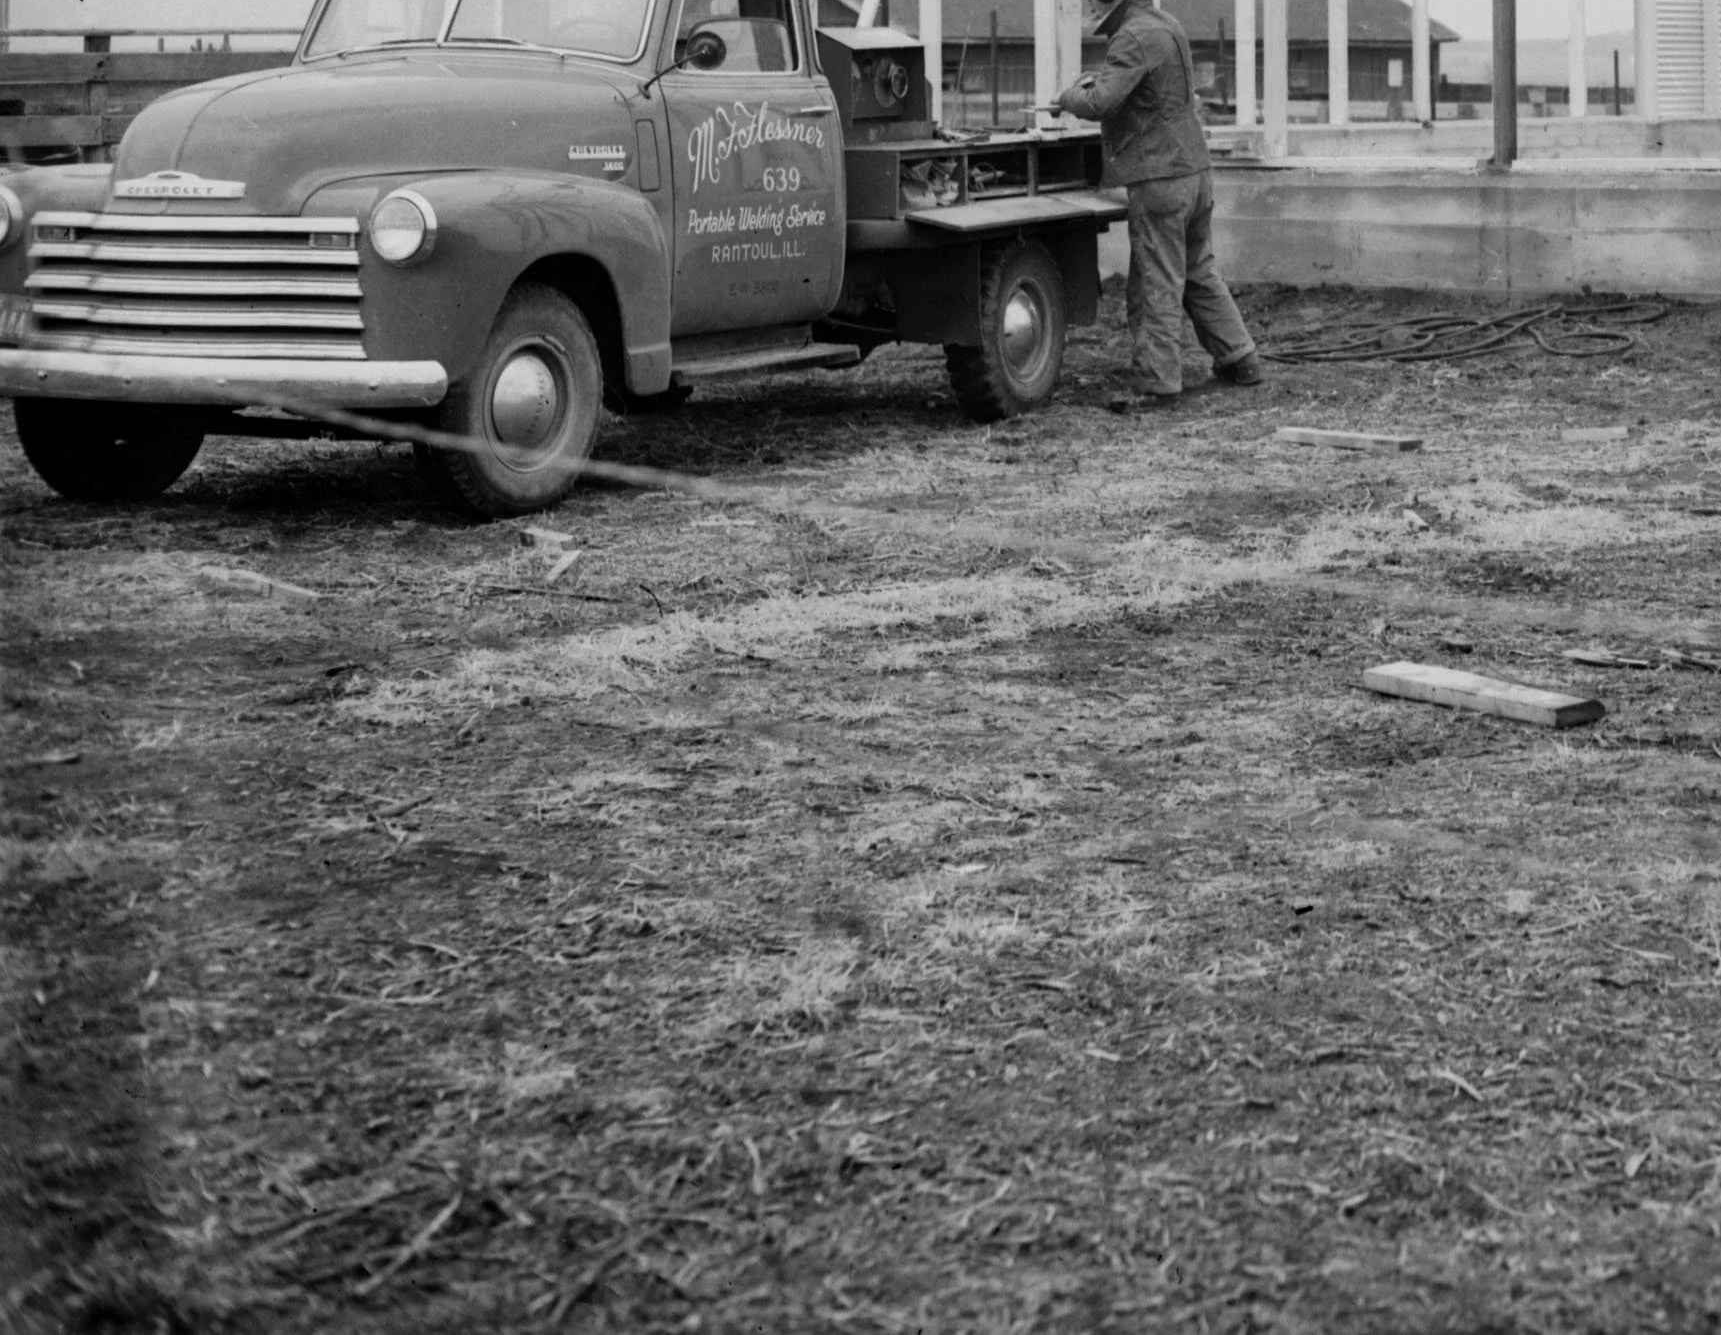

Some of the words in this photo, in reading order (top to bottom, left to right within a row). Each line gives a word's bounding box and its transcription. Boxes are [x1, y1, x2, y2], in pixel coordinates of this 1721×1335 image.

[567, 145, 626, 157] CHEVROLET
[763, 166, 801, 192] 639
[127, 185, 214, 195] CHEVROLET
[688, 207, 736, 234] Portable
[738, 201, 784, 237] Welding
[786, 201, 826, 229] Service
